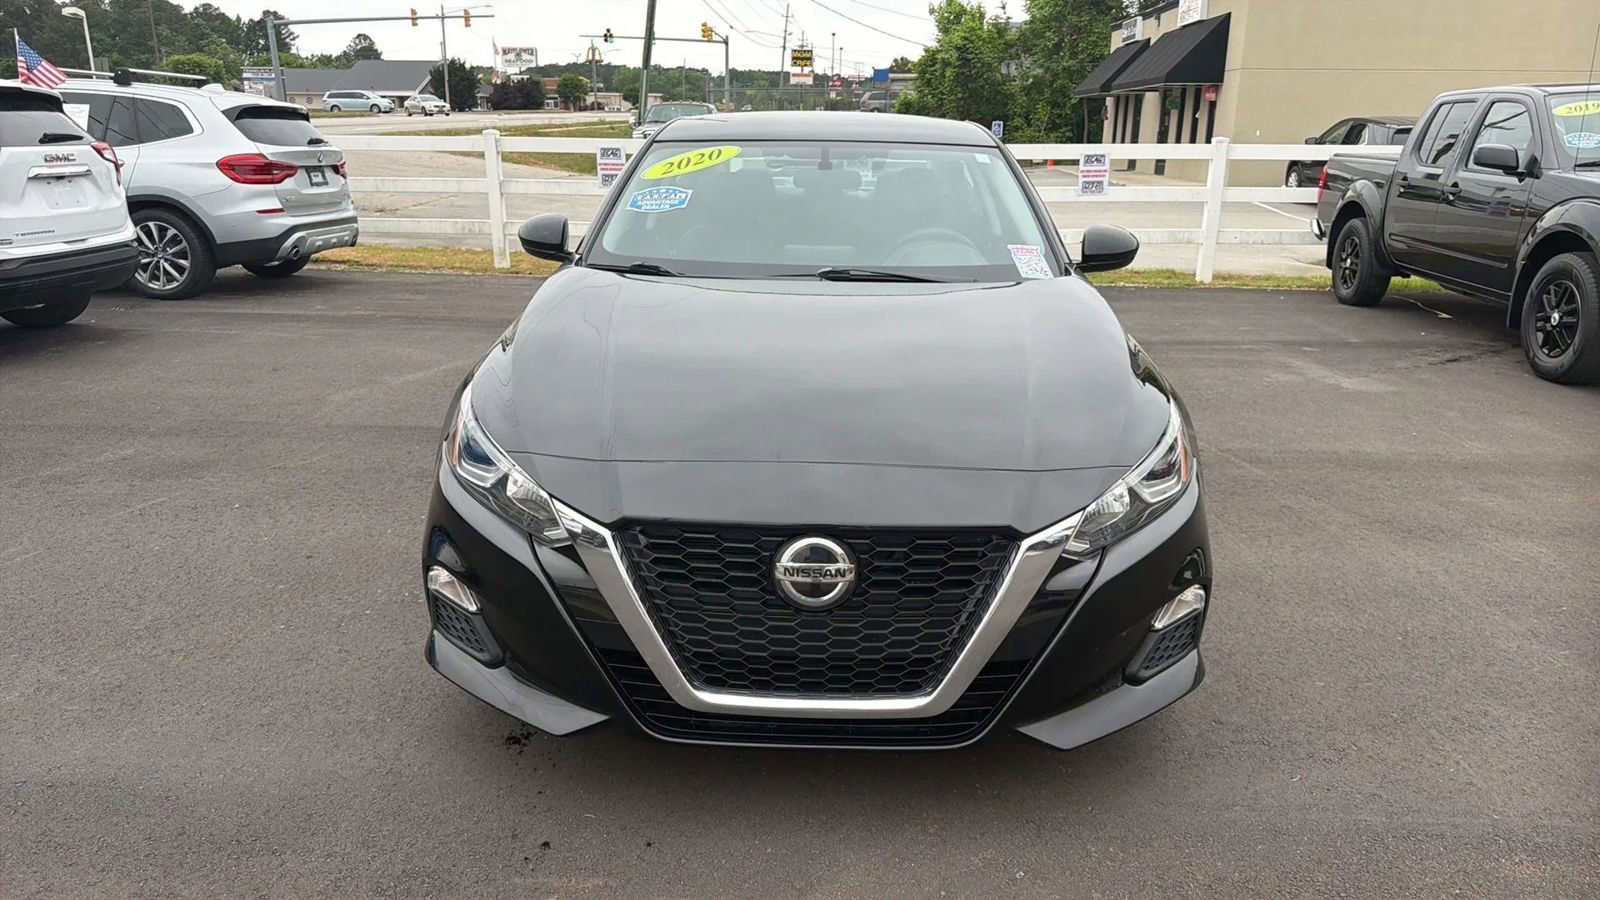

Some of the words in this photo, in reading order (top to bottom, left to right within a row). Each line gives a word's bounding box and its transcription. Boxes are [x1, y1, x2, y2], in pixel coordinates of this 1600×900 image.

[1566, 103, 1600, 114] 2019
[44, 153, 77, 163] GMC
[661, 148, 722, 176] 2020
[783, 567, 847, 579] NISSAN
